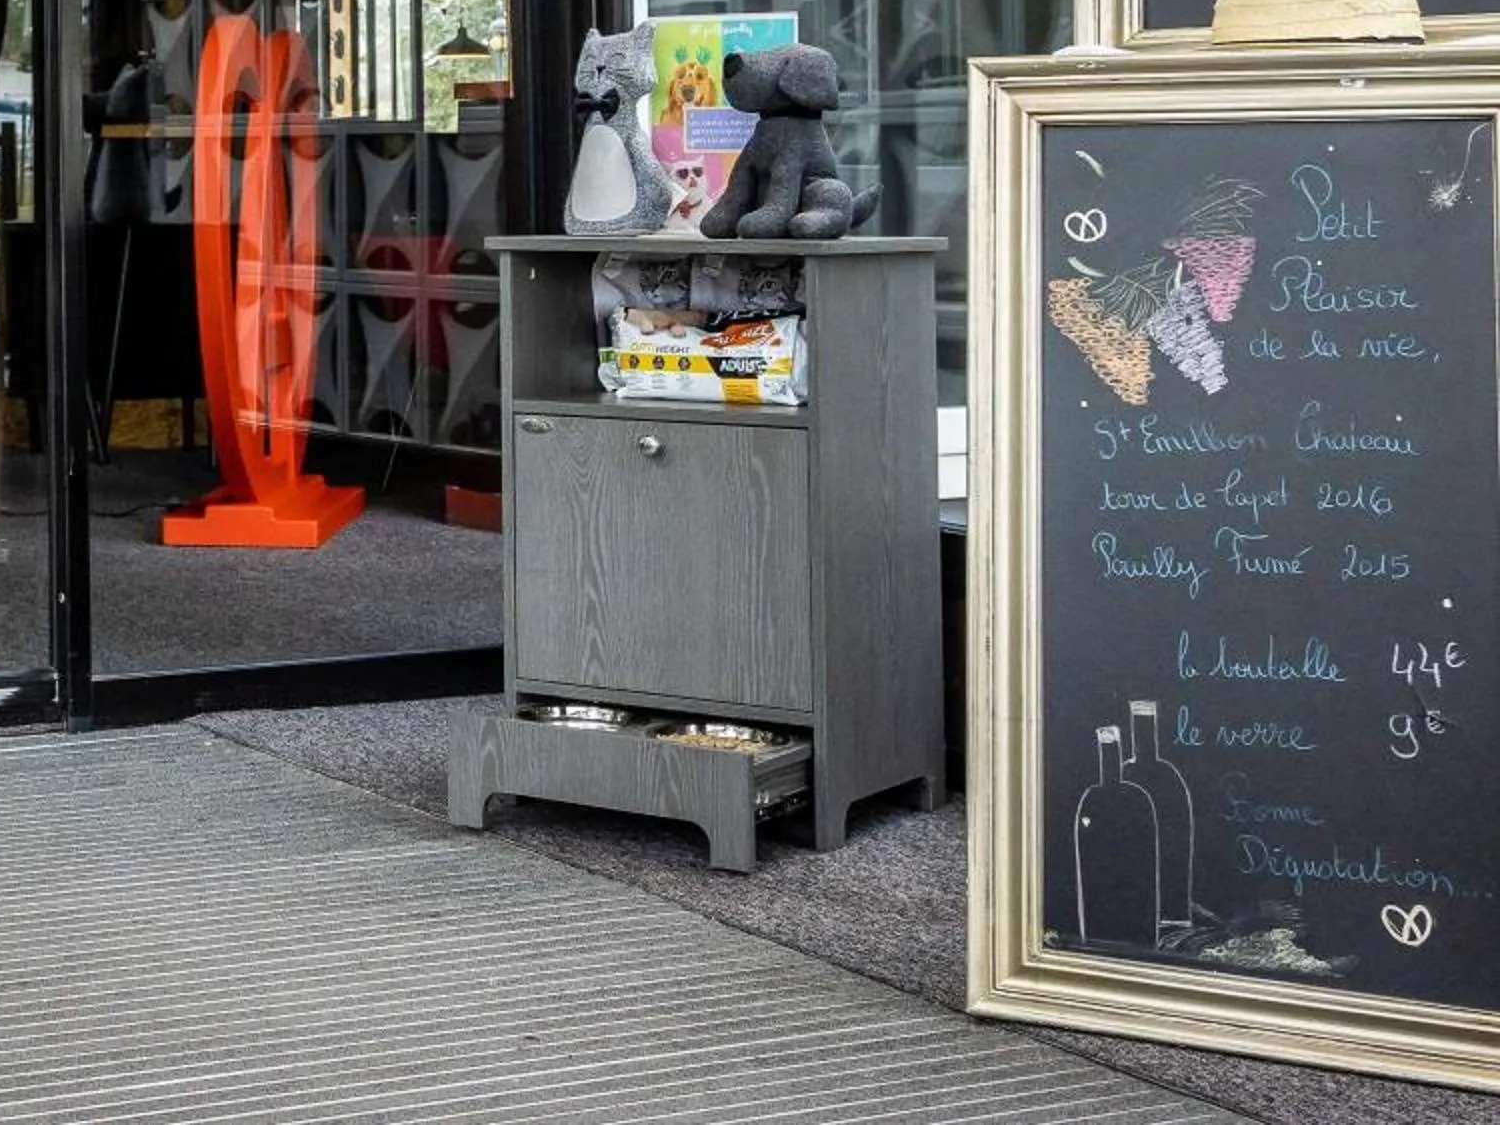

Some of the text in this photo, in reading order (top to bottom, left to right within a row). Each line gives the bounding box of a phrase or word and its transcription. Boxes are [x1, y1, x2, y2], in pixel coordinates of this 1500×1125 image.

[1291, 164, 1385, 242] Petit
[1270, 255, 1419, 312] Plaisir
[1250, 327, 1285, 360] de
[1299, 330, 1341, 359] la
[1100, 482, 1168, 511] tour
[1174, 482, 1208, 510] de
[1316, 482, 1393, 515] 2016
[1215, 526, 1313, 574] Fumé
[1341, 544, 1410, 581] 2015
[1173, 705, 1205, 746] le
[1216, 721, 1319, 751] verre
